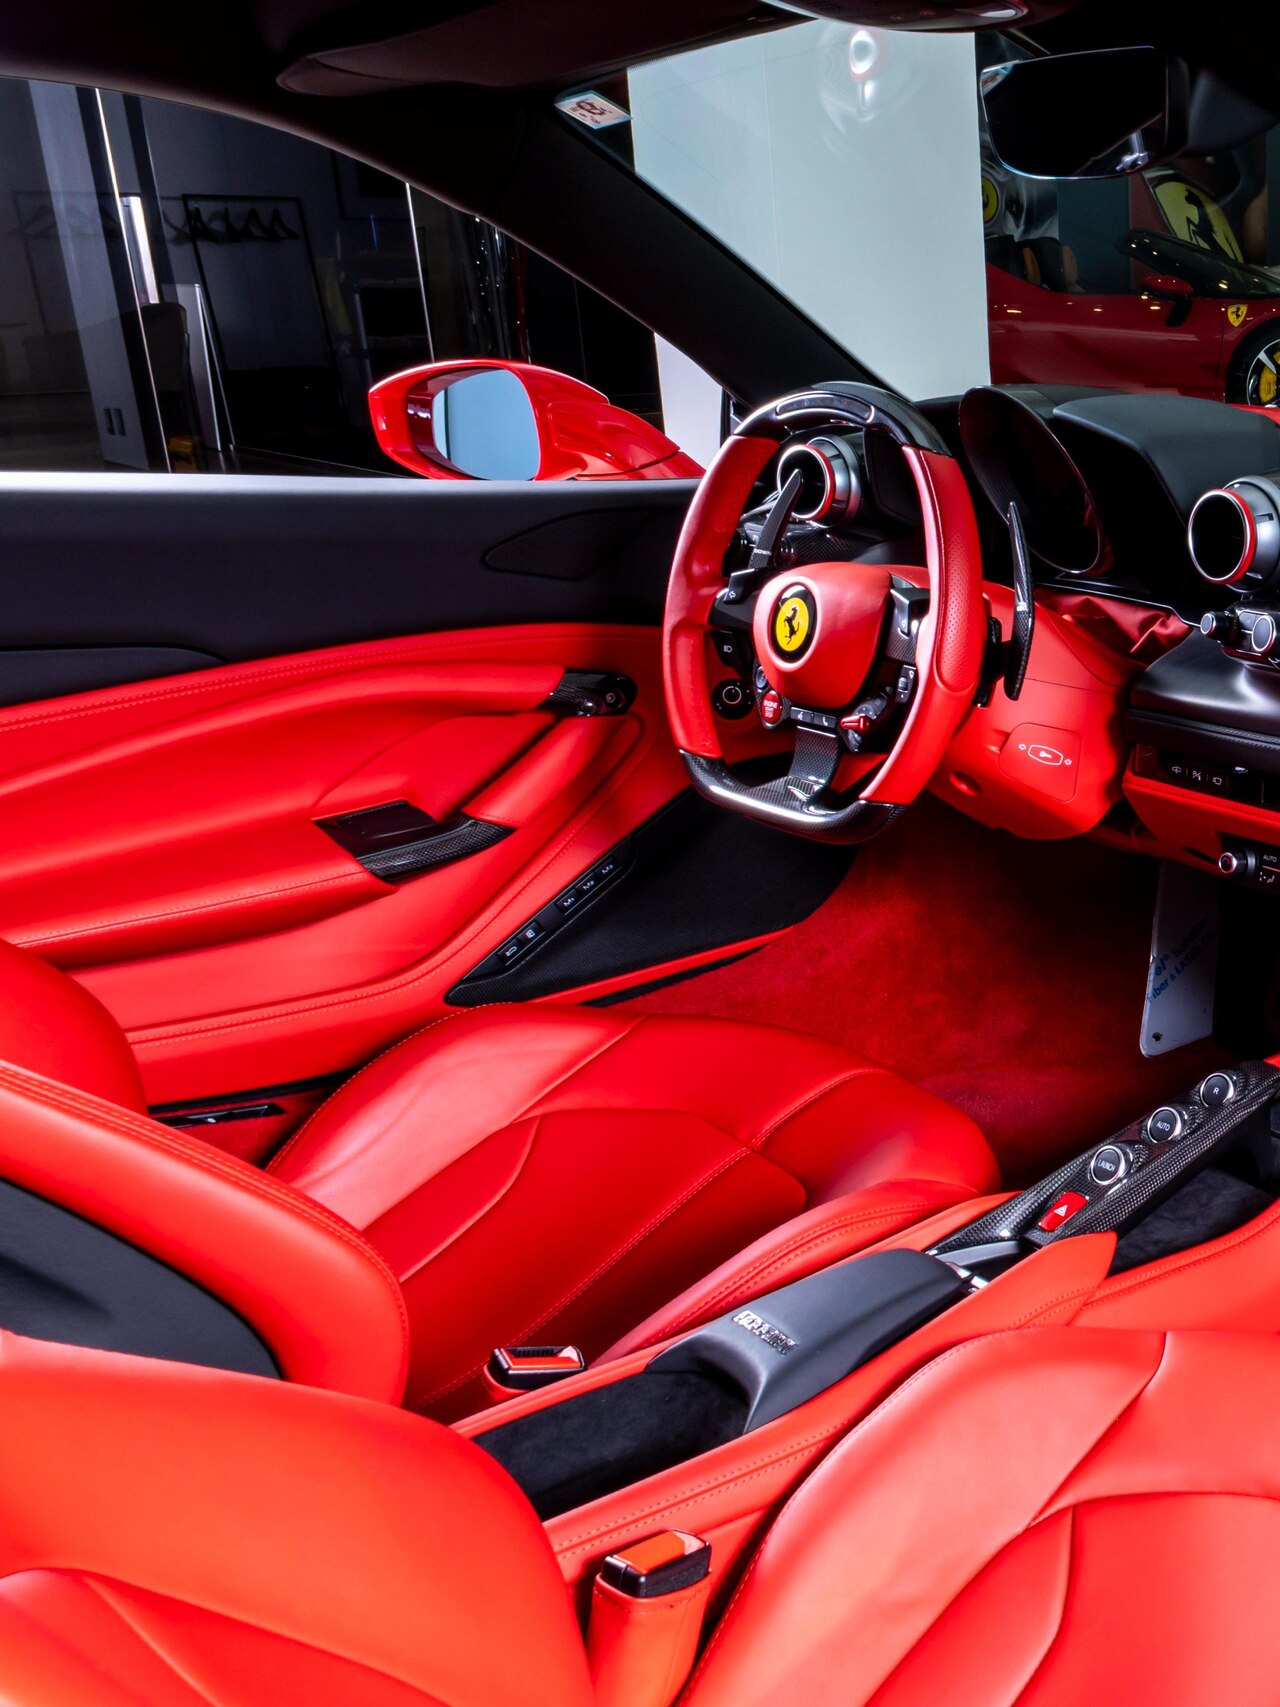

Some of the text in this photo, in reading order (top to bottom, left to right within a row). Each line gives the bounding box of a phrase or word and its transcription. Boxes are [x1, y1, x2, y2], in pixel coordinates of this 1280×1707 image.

[1262, 854, 1278, 863] AUTO
[1212, 1087, 1220, 1095] R
[1156, 1120, 1171, 1132] AUTO
[1097, 1160, 1117, 1173] LAUNCH
